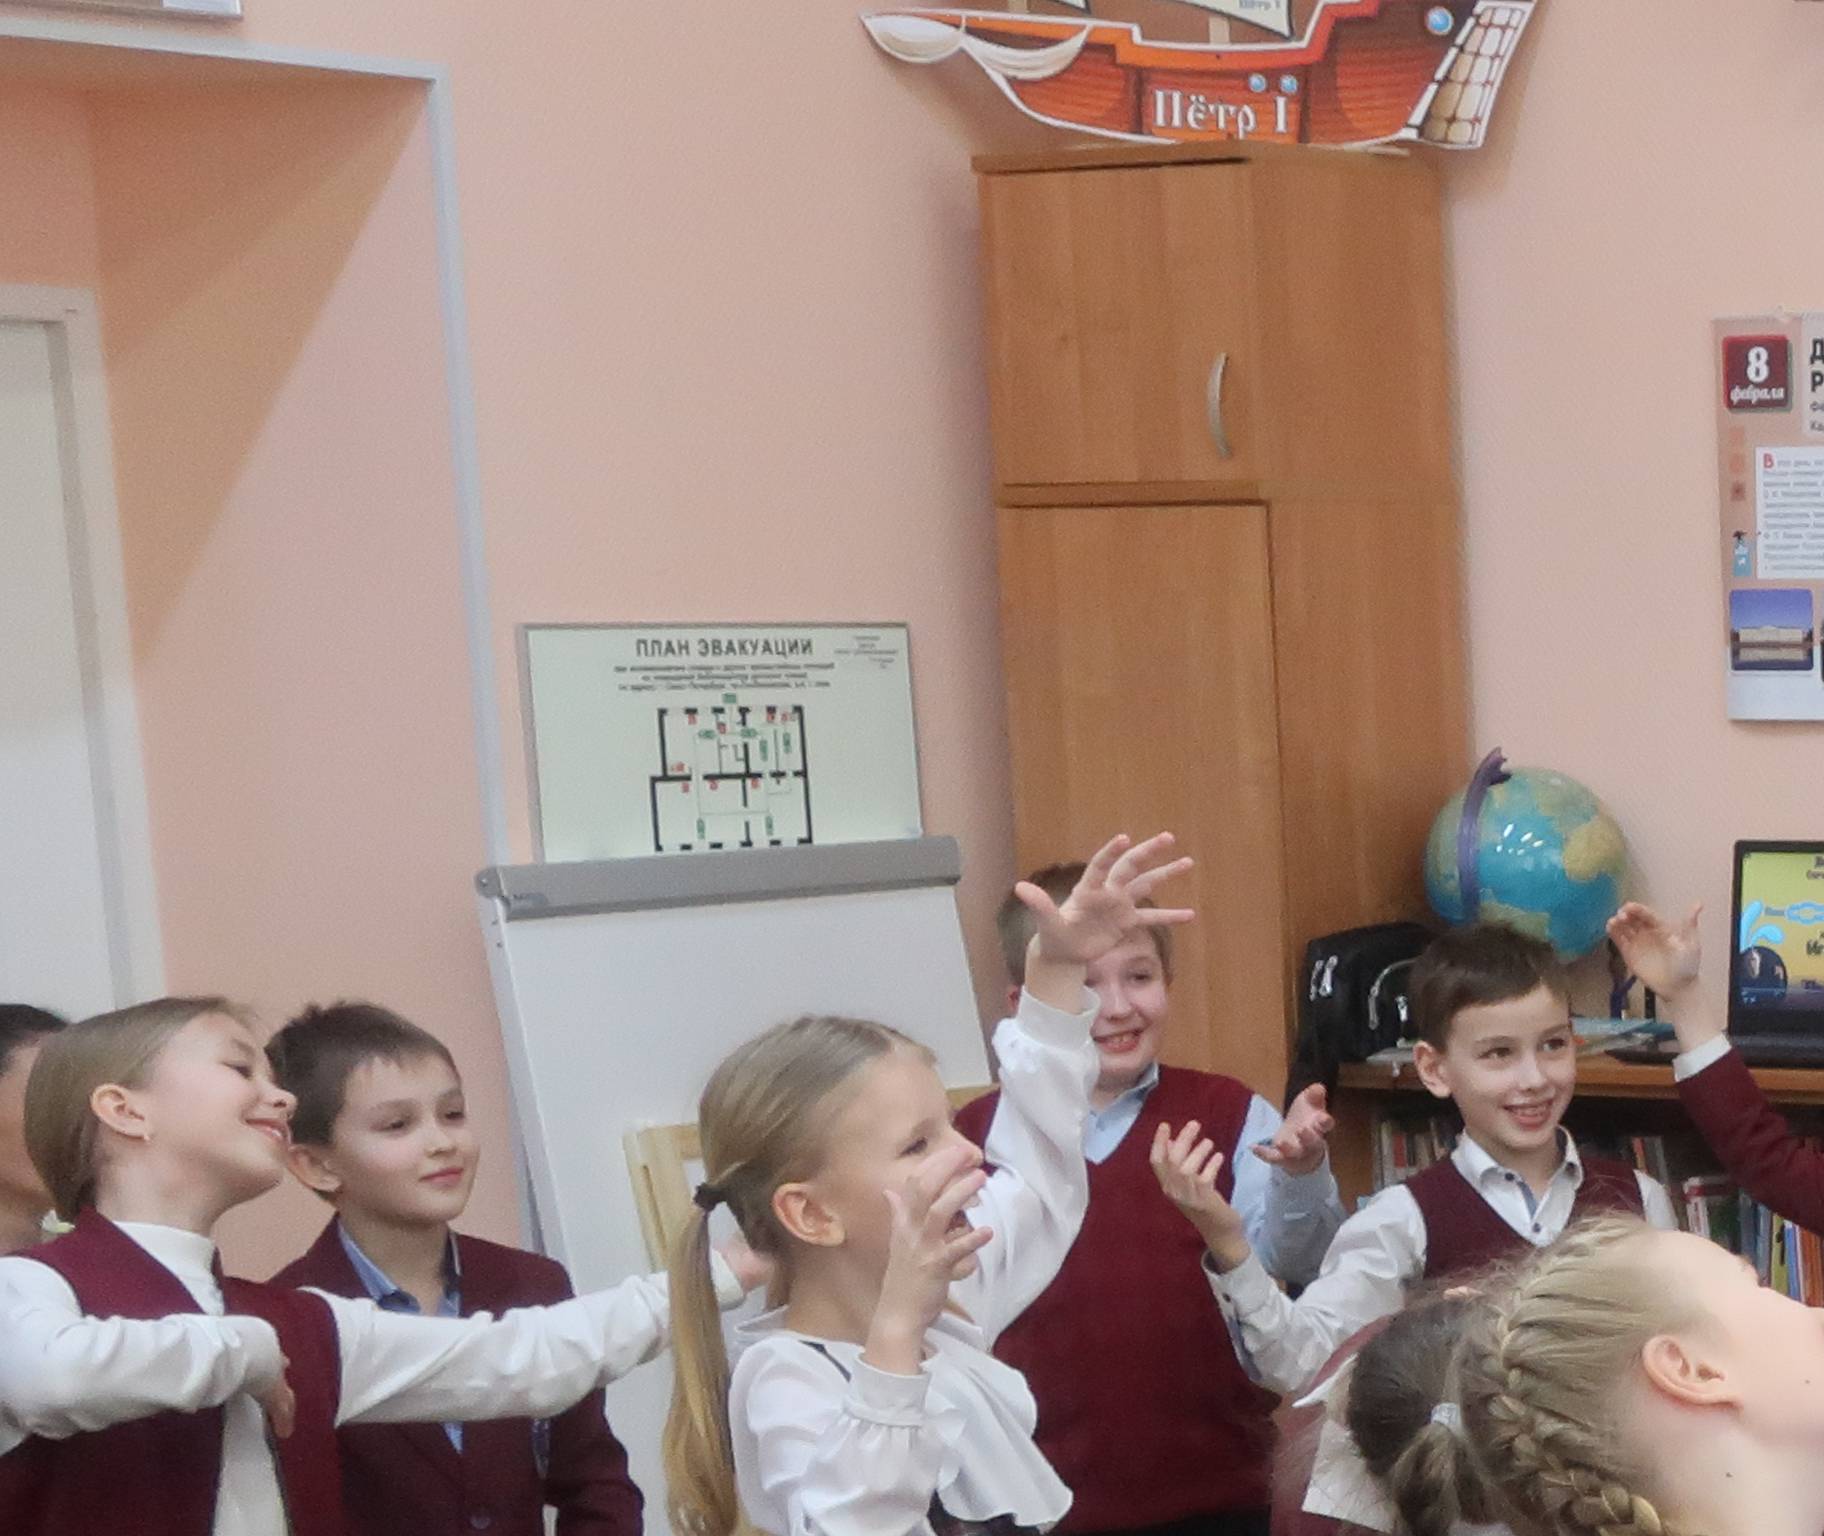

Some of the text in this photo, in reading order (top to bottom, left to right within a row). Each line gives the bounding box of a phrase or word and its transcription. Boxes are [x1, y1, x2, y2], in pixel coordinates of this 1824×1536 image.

[1154, 89, 1257, 140] Пётр
[1746, 346, 1770, 383] 8
[1730, 384, 1785, 405] февраля
[636, 638, 690, 657] ПЛАН
[699, 637, 813, 658] ЭВАКУАЦИИ
